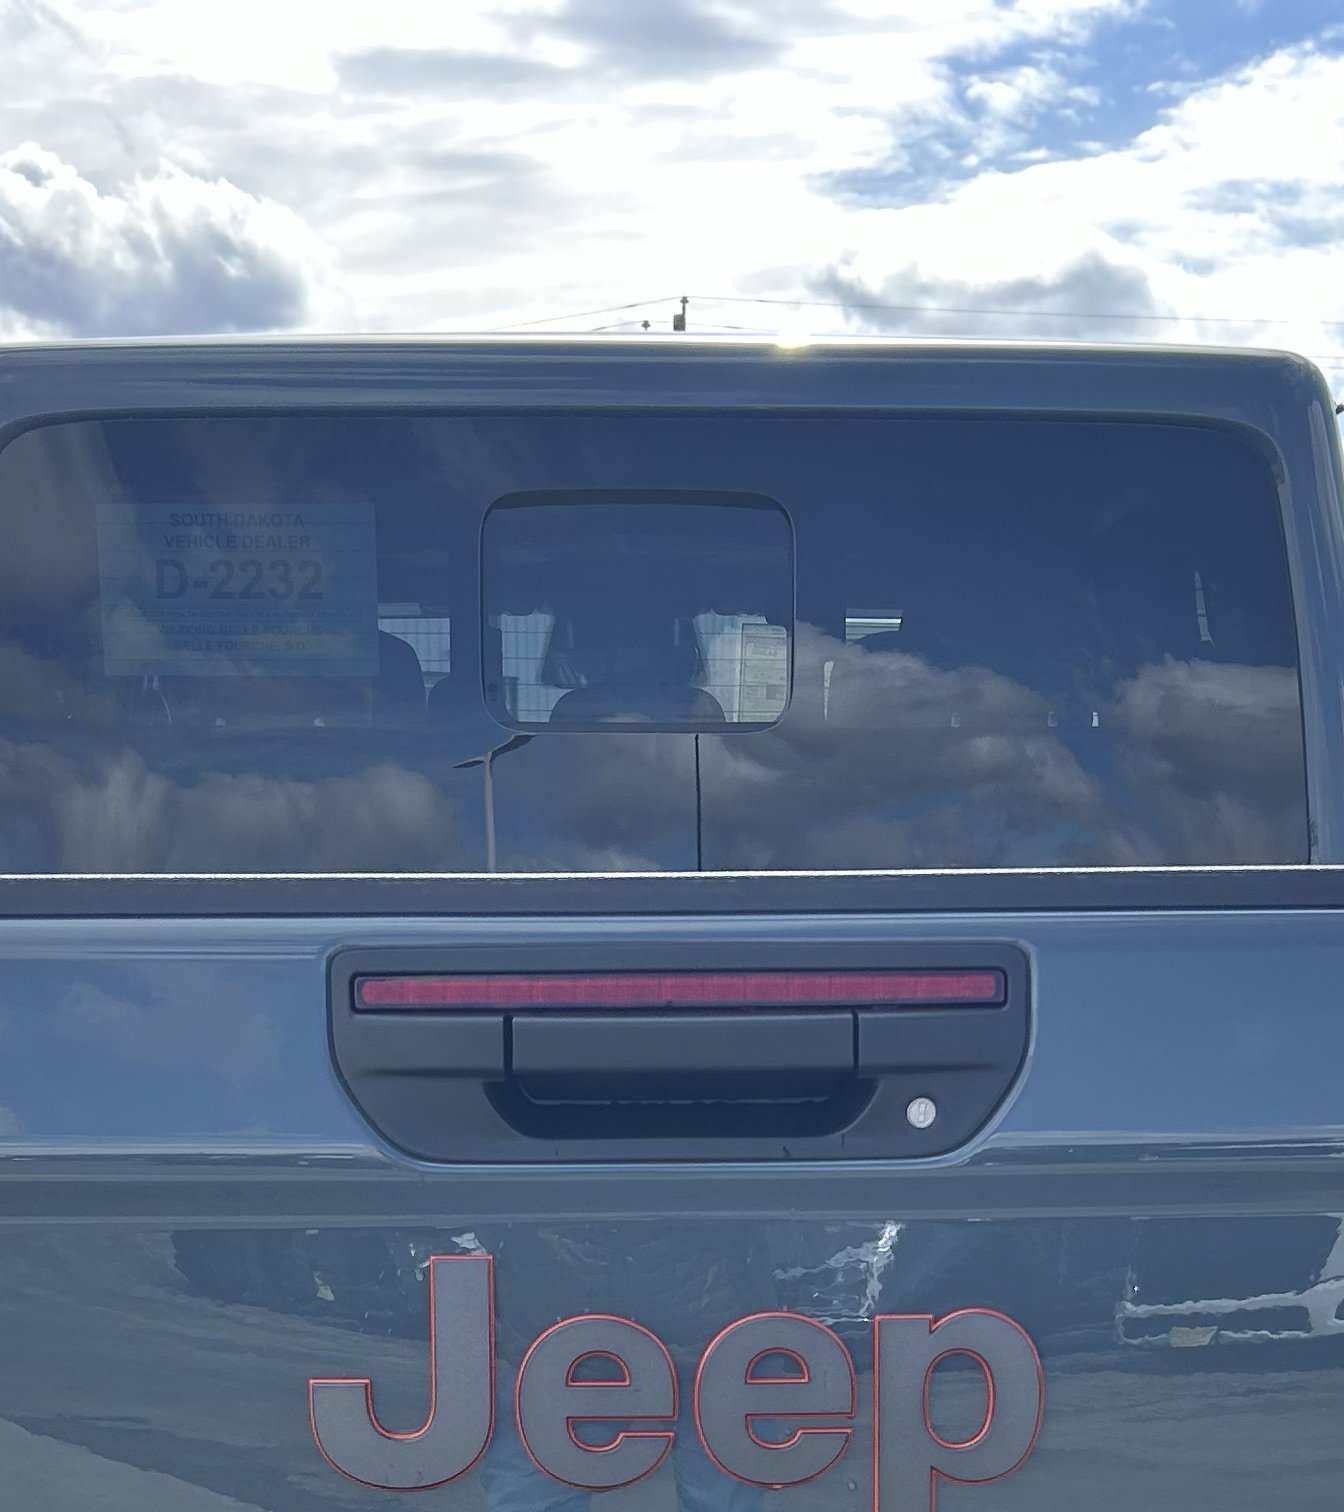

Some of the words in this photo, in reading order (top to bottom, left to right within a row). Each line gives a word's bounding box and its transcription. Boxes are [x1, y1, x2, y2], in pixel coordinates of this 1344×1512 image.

[169, 512, 229, 528] SOUTH
[233, 512, 306, 528] DAKOTA
[163, 534, 238, 549] VEHICLE
[242, 534, 311, 550] DEALER
[156, 558, 325, 601] D-2232
